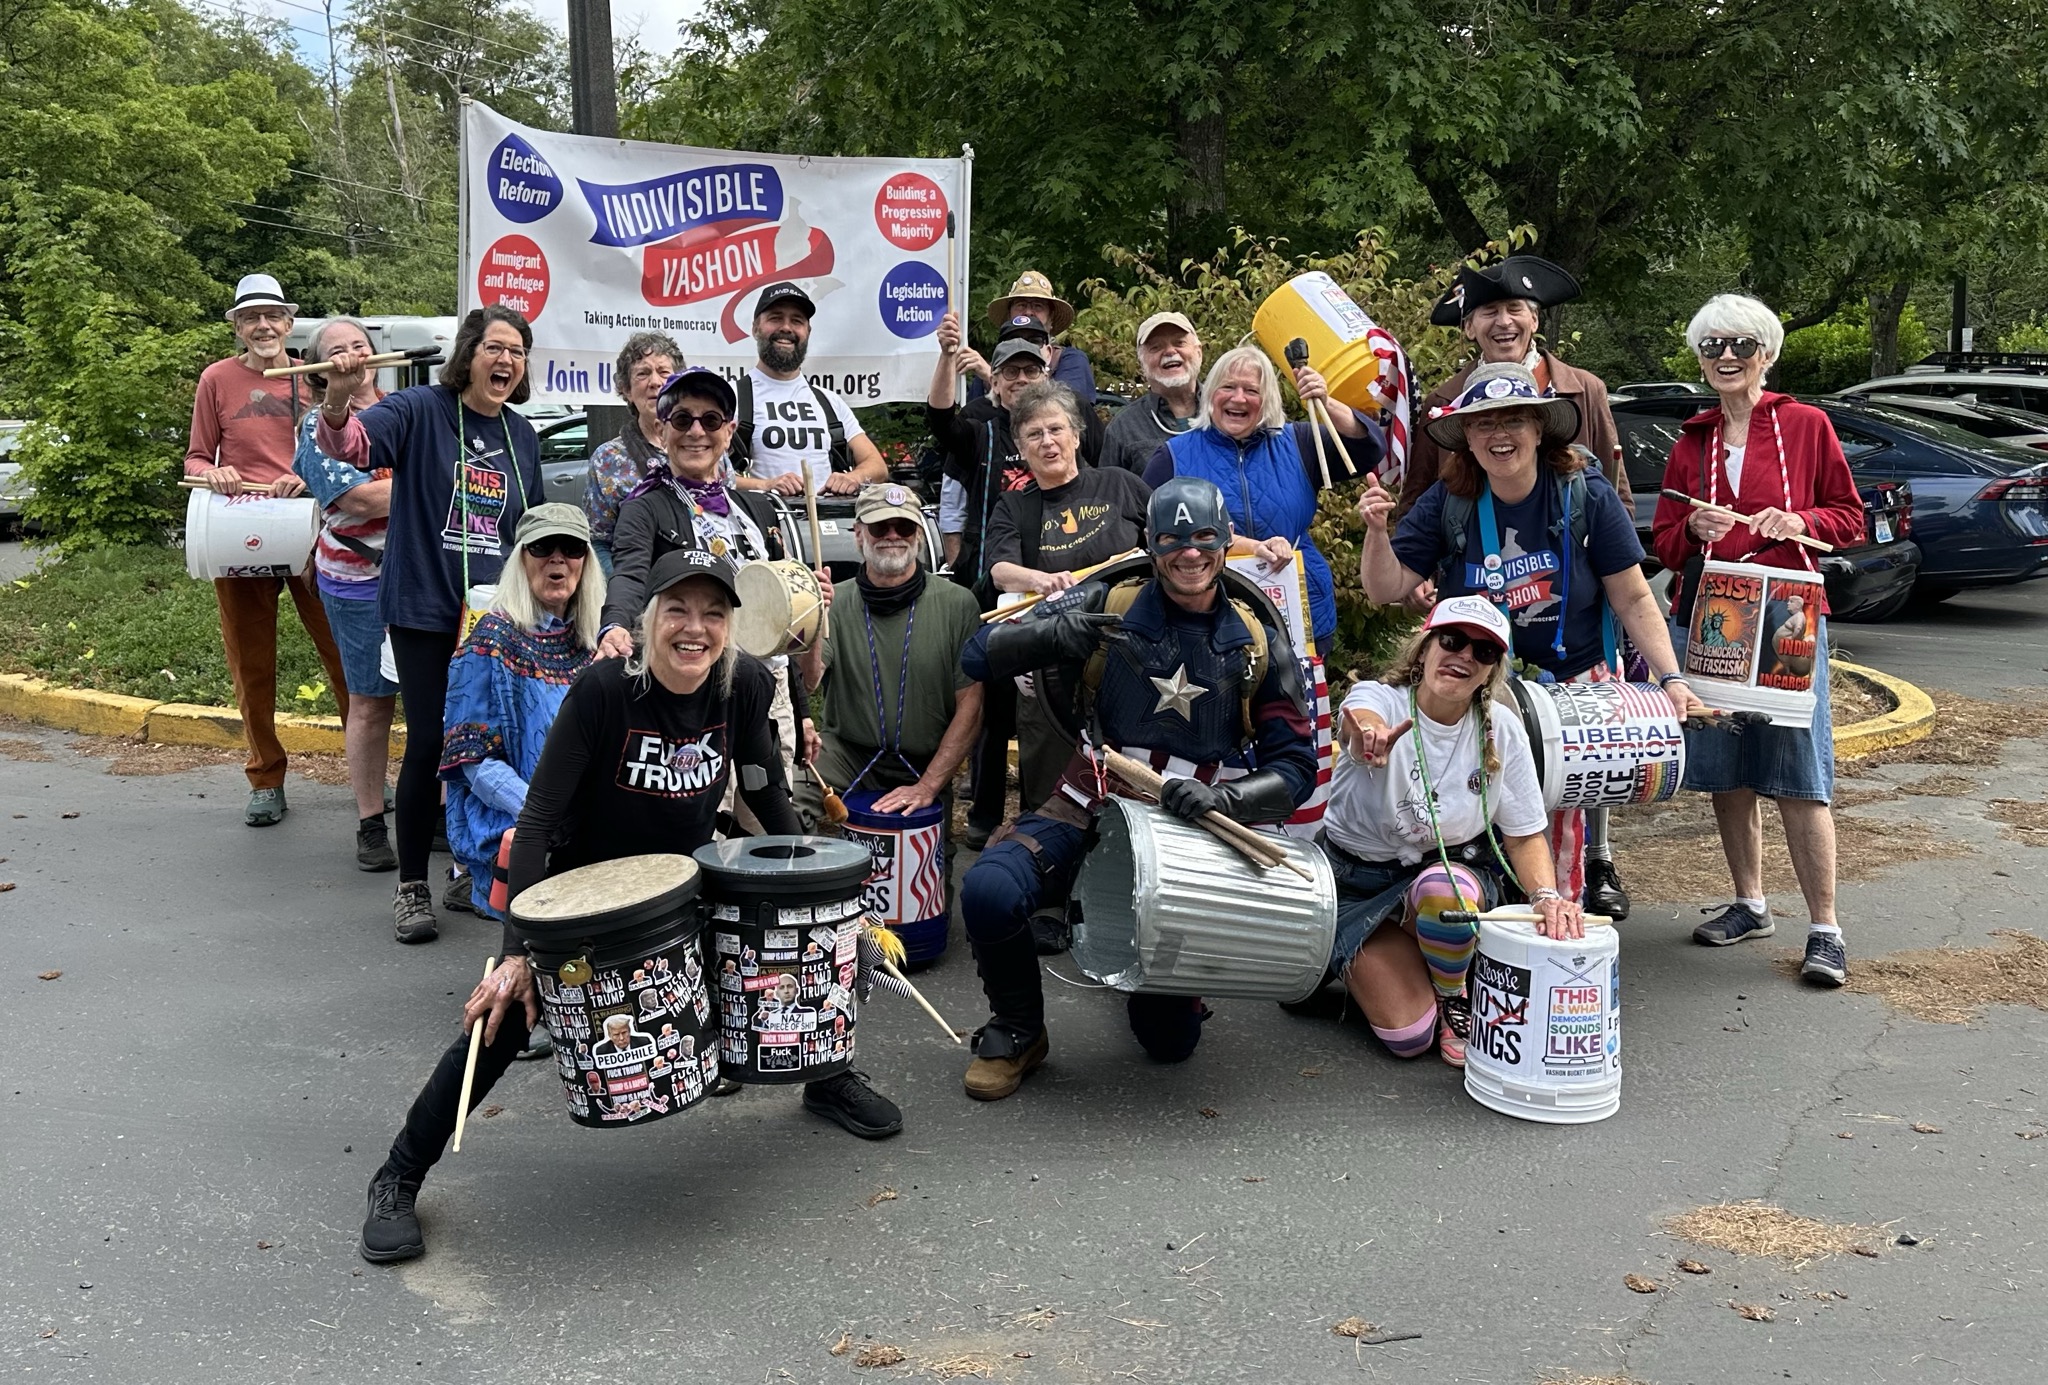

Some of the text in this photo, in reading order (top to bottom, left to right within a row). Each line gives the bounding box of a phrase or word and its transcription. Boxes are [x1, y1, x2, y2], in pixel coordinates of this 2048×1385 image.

[500, 147, 553, 178] Election
[498, 178, 551, 206] Reform
[886, 185, 936, 202] Building a
[602, 172, 768, 239] INDIVISIBLE
[882, 205, 942, 221] Progressive
[891, 223, 934, 240] Majority
[492, 248, 541, 270] Immigrant
[662, 239, 763, 298] VASHON
[484, 272, 545, 292] and Refugee
[769, 288, 789, 298] LAND
[886, 282, 945, 302] Legislative
[499, 295, 529, 313] Rights
[583, 311, 717, 334] Taking Action for Democracy
[895, 306, 933, 322] Action
[545, 359, 613, 394] Join U
[765, 400, 817, 422] ICE
[761, 426, 826, 450] OUT
[463, 465, 501, 489] THIS
[456, 489, 504, 507] DMOCRACY
[468, 482, 506, 499] WHAT
[450, 508, 497, 535] LIKE
[1173, 502, 1194, 526] A
[682, 550, 717, 564] FUCK
[689, 557, 711, 568] ICE
[1475, 553, 1554, 585] INVISIBLE
[1498, 585, 1541, 608] SHON
[1704, 642, 1748, 660] DEMOCRACY
[1703, 659, 1745, 677] FASCISM
[1575, 699, 1604, 725] SAY
[1561, 725, 1681, 744] LIBERAL
[638, 732, 719, 762] FUK
[1564, 739, 1682, 761] PATRIOT
[626, 754, 724, 793] TRUMP
[1560, 772, 1584, 804] YOUR
[1595, 768, 1635, 808] OICE
[761, 951, 776, 961] TRUMP
[590, 969, 621, 982] UCK
[801, 961, 831, 975] FUCK
[1480, 956, 1521, 991] People
[586, 977, 624, 996] DNALD
[659, 969, 685, 998] FUCK
[801, 969, 832, 987] DNALD
[590, 990, 626, 1008] TRUMP
[662, 976, 690, 1009] DNALD
[721, 992, 747, 1004] FUCK
[801, 982, 832, 999] TRUMP
[1471, 981, 1490, 1018] NO
[1555, 988, 1598, 1005] THIS
[559, 1006, 586, 1015] FUCK
[668, 986, 693, 1018] TRUMP
[720, 1001, 748, 1017] DNALD
[1552, 1004, 1601, 1015] IS WHAT
[600, 1005, 632, 1018] WARNING
[781, 1014, 805, 1023] NAZI
[1551, 1014, 1601, 1023] DEMOCRACY
[560, 1014, 589, 1029] DNALD
[721, 1013, 748, 1029] TRUMP
[769, 1022, 789, 1031] PIECE
[801, 1021, 815, 1030] SHIT
[1550, 1022, 1601, 1035] SOUNDS
[562, 1026, 591, 1040] TRUMP
[721, 1028, 747, 1040] FUCK
[762, 1033, 798, 1043] FUCK TRUMP
[804, 1028, 832, 1041] FUCK
[1470, 1013, 1522, 1066] INGS
[700, 1041, 716, 1061] FUCK
[720, 1036, 748, 1053] DNALD
[770, 1047, 792, 1056] Fuck
[803, 1037, 833, 1054] DNALD
[1550, 1034, 1601, 1055] LIKE
[597, 1045, 655, 1067] PEDOPHILE
[701, 1050, 718, 1074] DNALD
[721, 1049, 748, 1065] TRUMP
[803, 1049, 833, 1066] TRUMP
[606, 1067, 623, 1079] FUCK
[622, 1063, 643, 1077] TRUMP
[670, 1066, 699, 1083] FUCK
[1545, 1067, 1566, 1077] VASHON
[1567, 1068, 1585, 1077] BUCKET
[564, 1080, 585, 1093] FUCK
[671, 1070, 702, 1097] DNALD
[564, 1087, 588, 1106] DNALD
[674, 1082, 703, 1108] TRUMP
